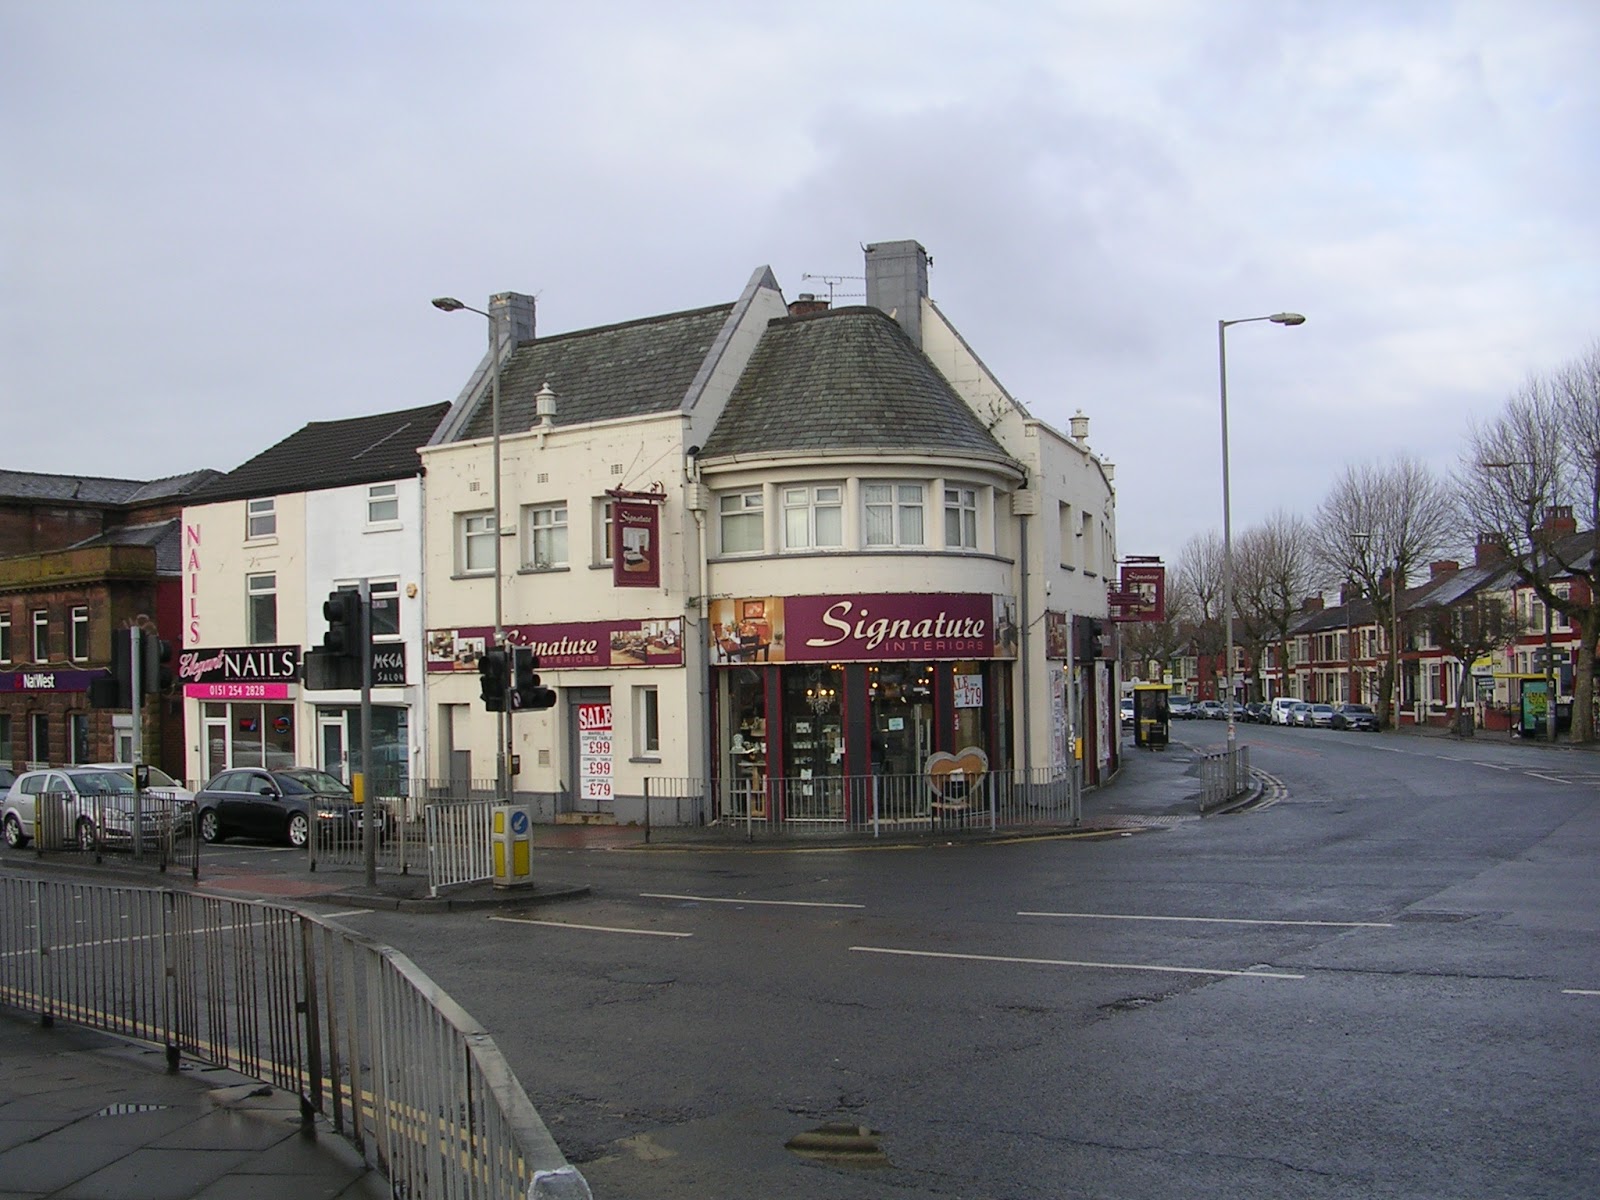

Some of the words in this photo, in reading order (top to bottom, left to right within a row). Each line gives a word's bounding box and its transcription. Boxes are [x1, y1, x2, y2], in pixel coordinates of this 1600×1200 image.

[187, 524, 201, 644] NAILS
[806, 601, 985, 650] Signature
[885, 641, 983, 651] INTERIORS
[225, 652, 294, 677] NAILS
[373, 653, 403, 669] MEGA
[540, 656, 599, 664] NTERIORS
[23, 673, 55, 688] NatWest
[210, 686, 226, 696] 0151
[229, 686, 242, 695] 254
[246, 686, 265, 696] 2828
[964, 687, 981, 704] £79
[579, 706, 612, 729] SALE
[589, 741, 610, 753] £99
[589, 762, 610, 774] £99
[590, 783, 611, 795] £79
